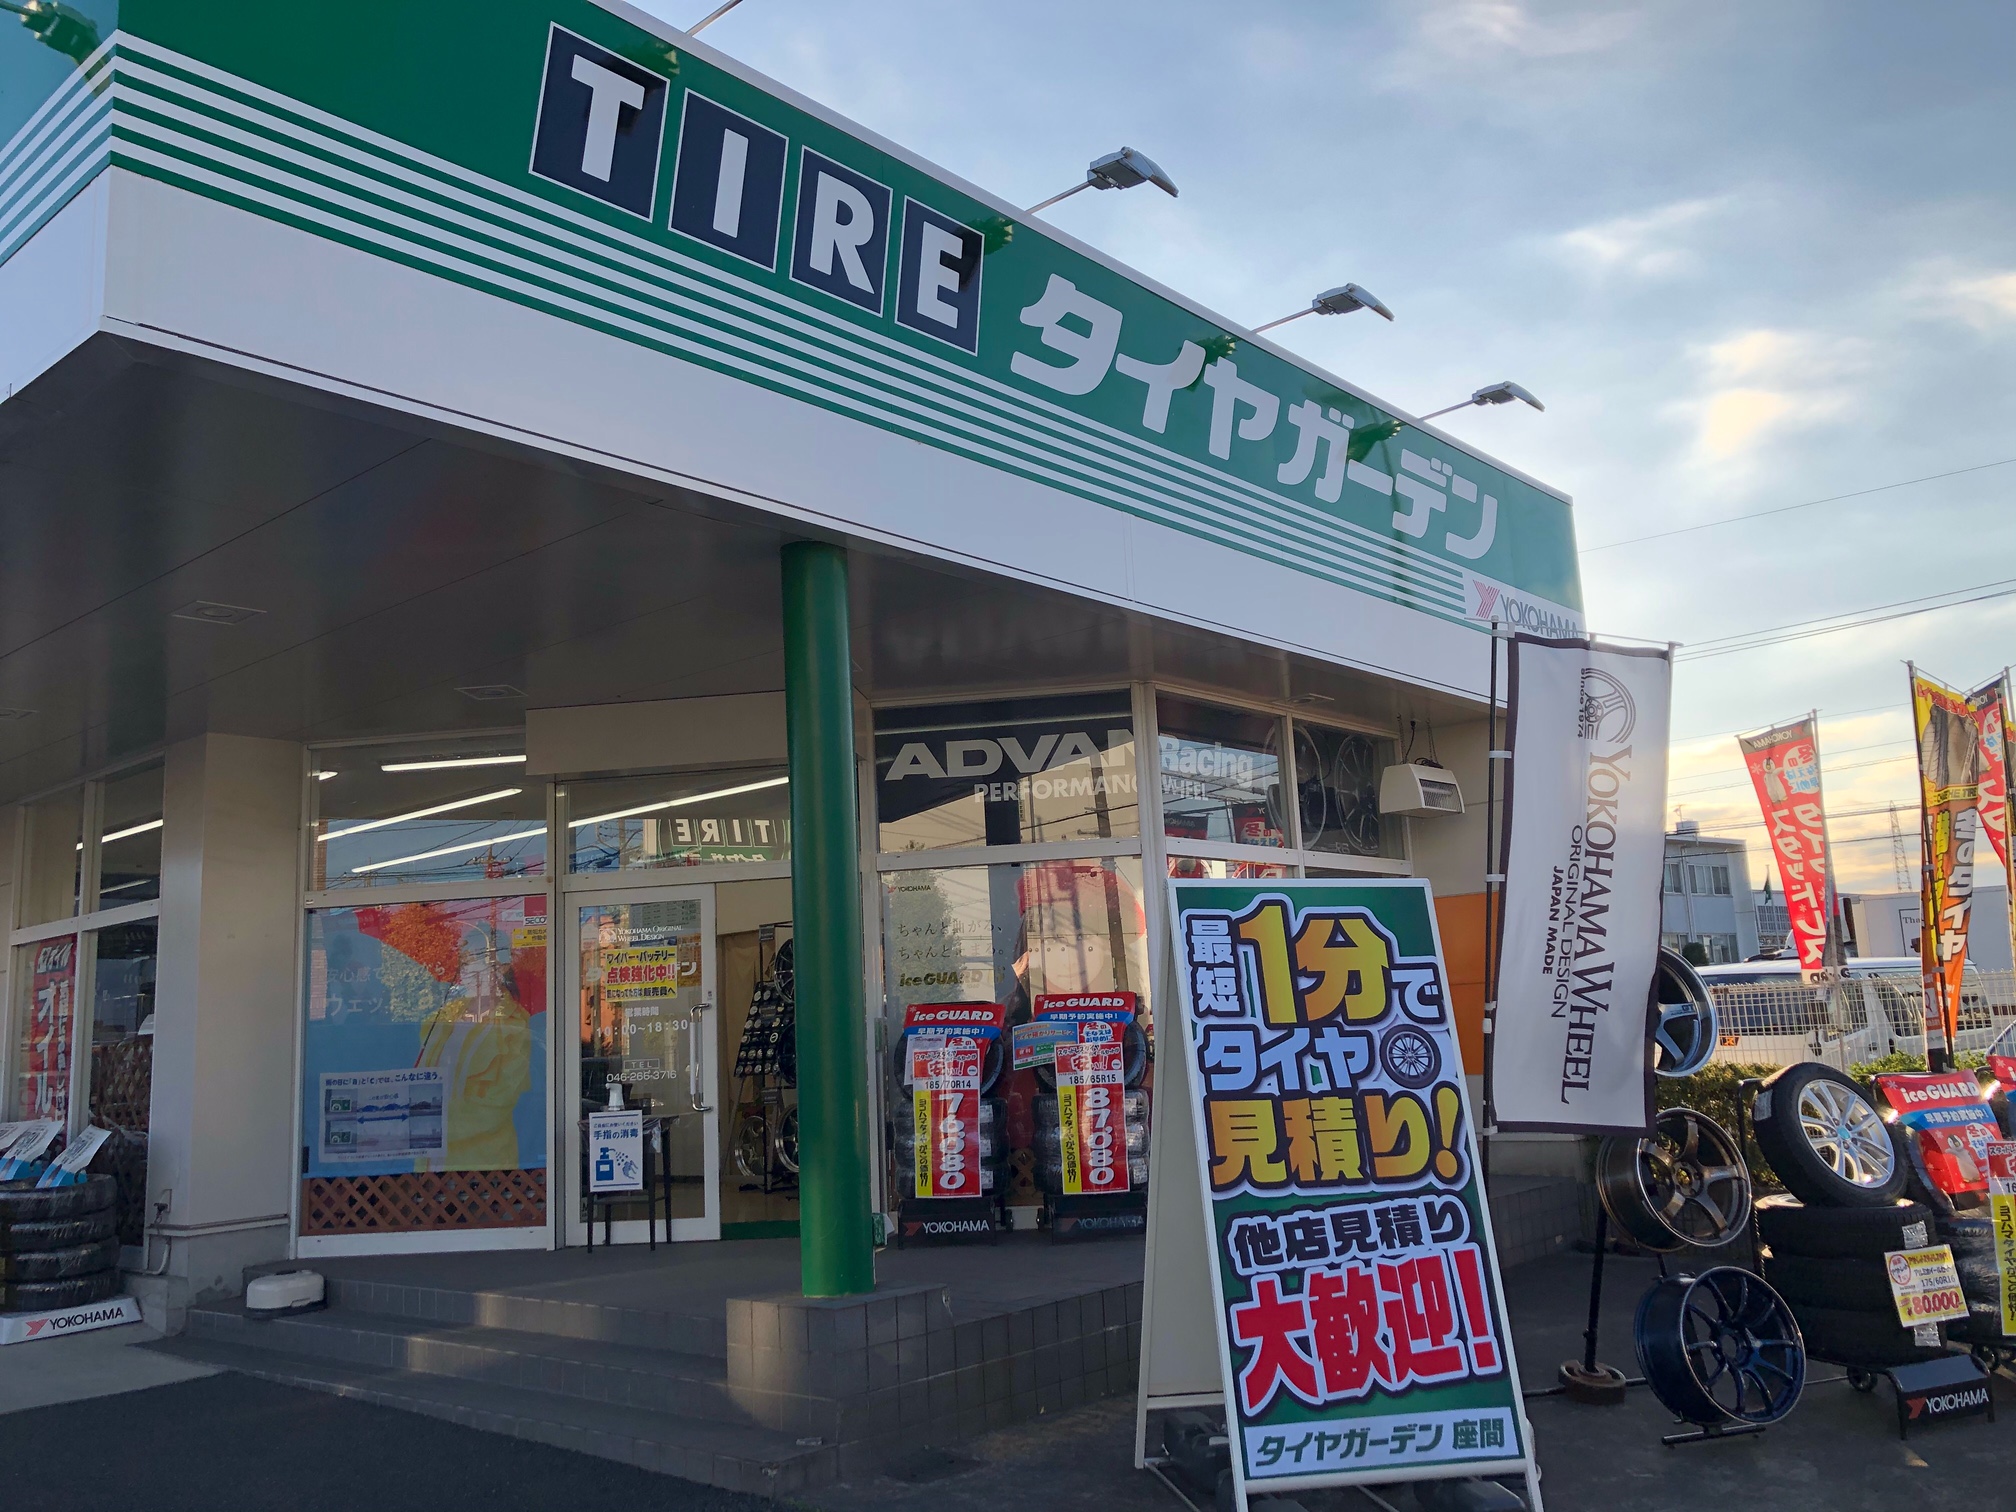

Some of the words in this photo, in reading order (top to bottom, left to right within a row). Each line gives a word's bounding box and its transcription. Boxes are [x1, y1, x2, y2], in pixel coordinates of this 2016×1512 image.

[571, 54, 963, 329] TIRE
[1010, 273, 1498, 559] タイヤガーデン
[1500, 593, 1579, 639] YOKOHAMA
[1158, 734, 1253, 790] Racing
[1562, 824, 1583, 933] ORIGINAL
[1573, 744, 1633, 963] YOKOHAMA
[1549, 865, 1564, 922] JAPAN
[1190, 919, 1241, 1013] 最短
[1238, 904, 1441, 1024] 1分で
[1542, 926, 1558, 975] MADE
[1550, 938, 1573, 1019] DESIGN
[913, 1010, 994, 1022] iceGUARD
[1043, 997, 1125, 1010] iceGUARD
[1204, 1027, 1370, 1091] タイヤ
[1561, 961, 1616, 1104] WHEEL
[631, 1060, 652, 1068] TEL
[1900, 1082, 1980, 1104] iceGUARD
[593, 1129, 639, 1141] 手指の消毒
[1209, 1086, 1460, 1186] 見積り!
[922, 1219, 990, 1234] YOKOHAMA
[1234, 1200, 1465, 1269] 他店見積り
[49, 1305, 124, 1331] YOKOHAMA
[1236, 1248, 1497, 1410] 大歓迎!
[1925, 1387, 1990, 1414] YOKOHAMA
[1254, 1422, 1444, 1467] タイヤガーデン
[1452, 1417, 1505, 1450] 座間
